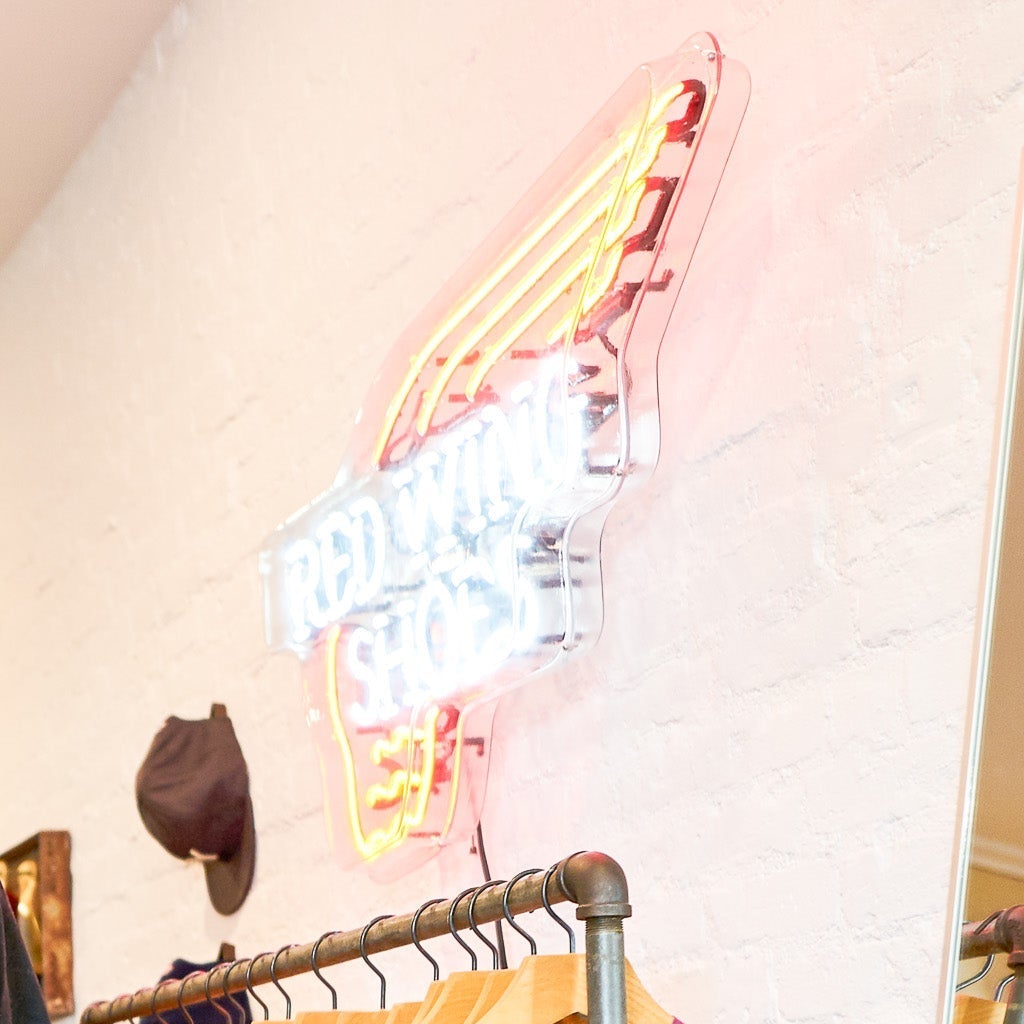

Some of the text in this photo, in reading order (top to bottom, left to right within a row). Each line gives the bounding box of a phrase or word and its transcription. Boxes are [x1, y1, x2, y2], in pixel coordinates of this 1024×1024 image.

[284, 353, 587, 643] RED WING
[347, 535, 540, 724] SHOES
